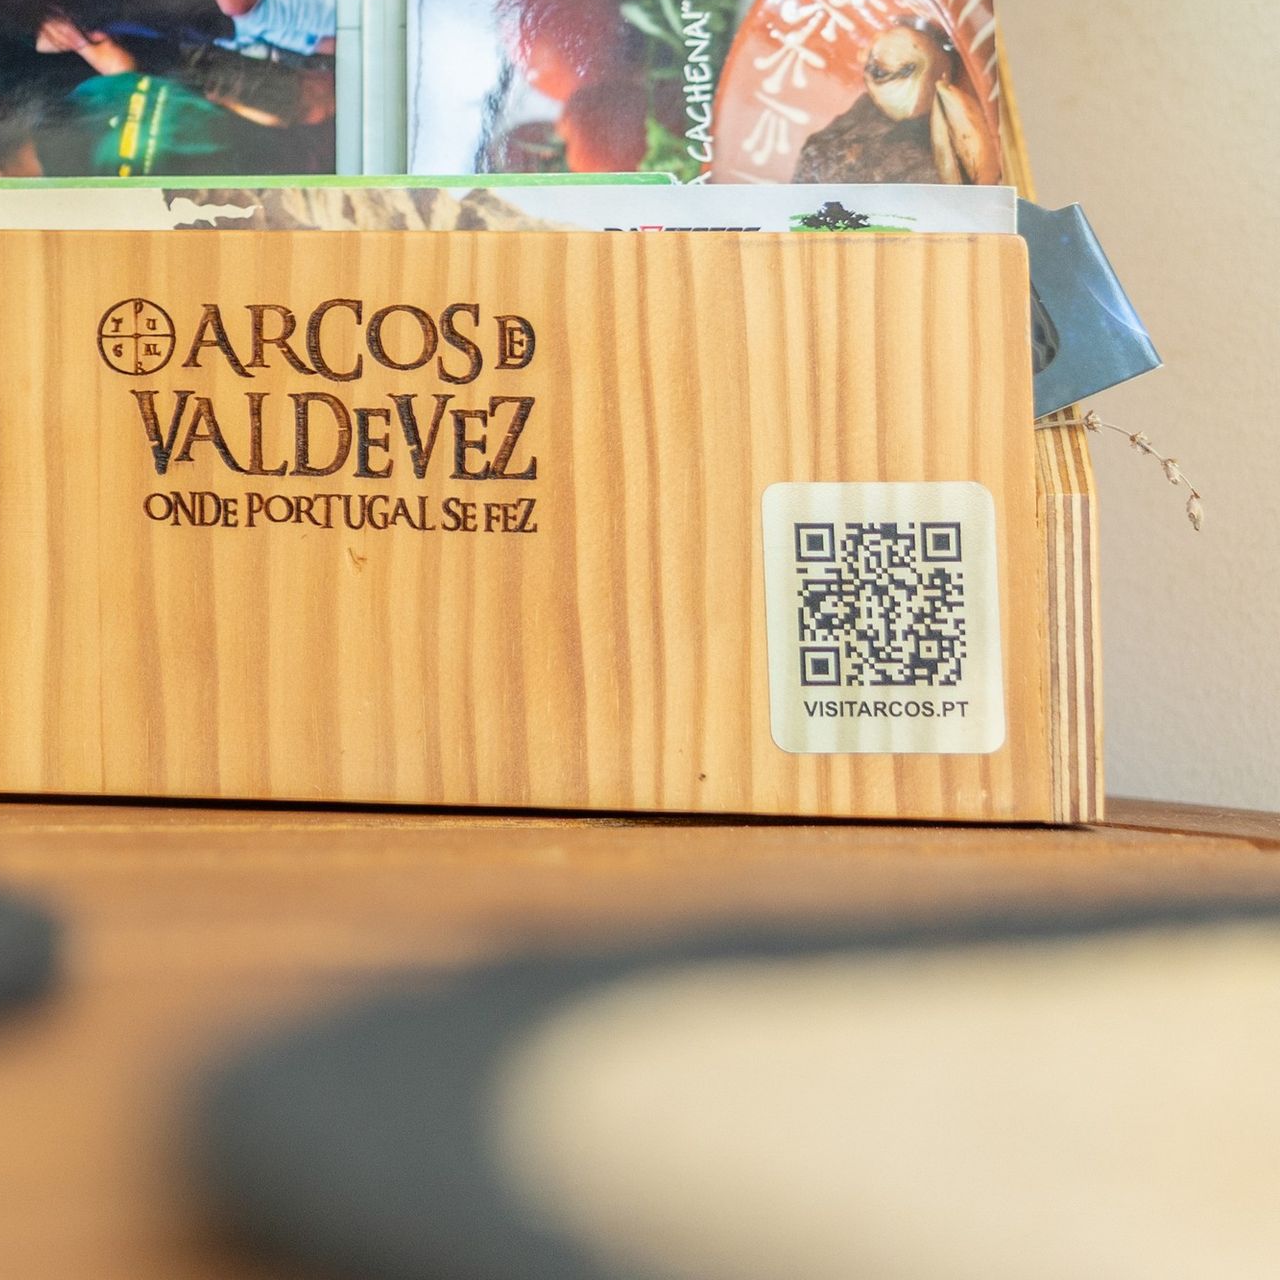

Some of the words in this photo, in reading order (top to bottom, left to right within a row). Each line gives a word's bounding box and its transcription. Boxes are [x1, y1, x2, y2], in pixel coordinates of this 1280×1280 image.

[182, 298, 483, 385] ARCOS
[130, 389, 538, 480] VALDEVEZ
[143, 491, 239, 529] ONDE
[246, 492, 437, 532] PORTUGAL
[442, 497, 479, 533] SE
[484, 497, 539, 534] FEZ
[803, 700, 970, 718] VISITARCOS.PT
